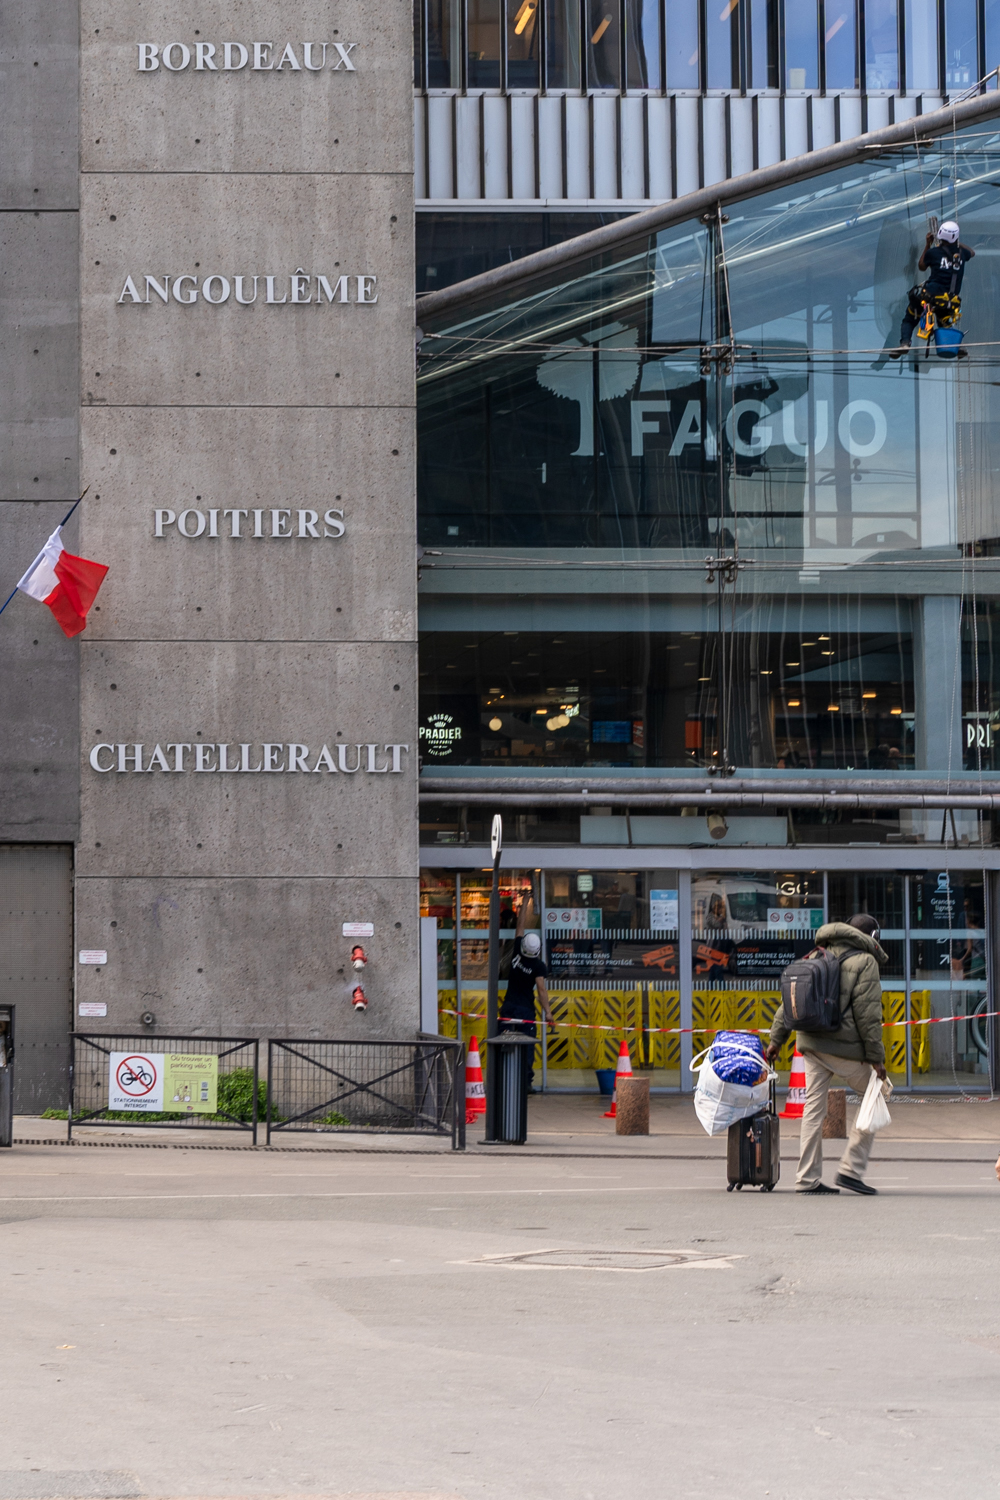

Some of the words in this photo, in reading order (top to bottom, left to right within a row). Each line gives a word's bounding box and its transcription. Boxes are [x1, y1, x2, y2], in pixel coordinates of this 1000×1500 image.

[136, 42, 357, 71] BORDEAUX
[117, 268, 378, 305] ANGOULÊME
[630, 399, 888, 458] FAGUO
[153, 508, 346, 538] POITIERS
[419, 727, 462, 739] PRADIER
[89, 743, 409, 773] CHATELLERAULT
[170, 1062, 193, 1070] parking
